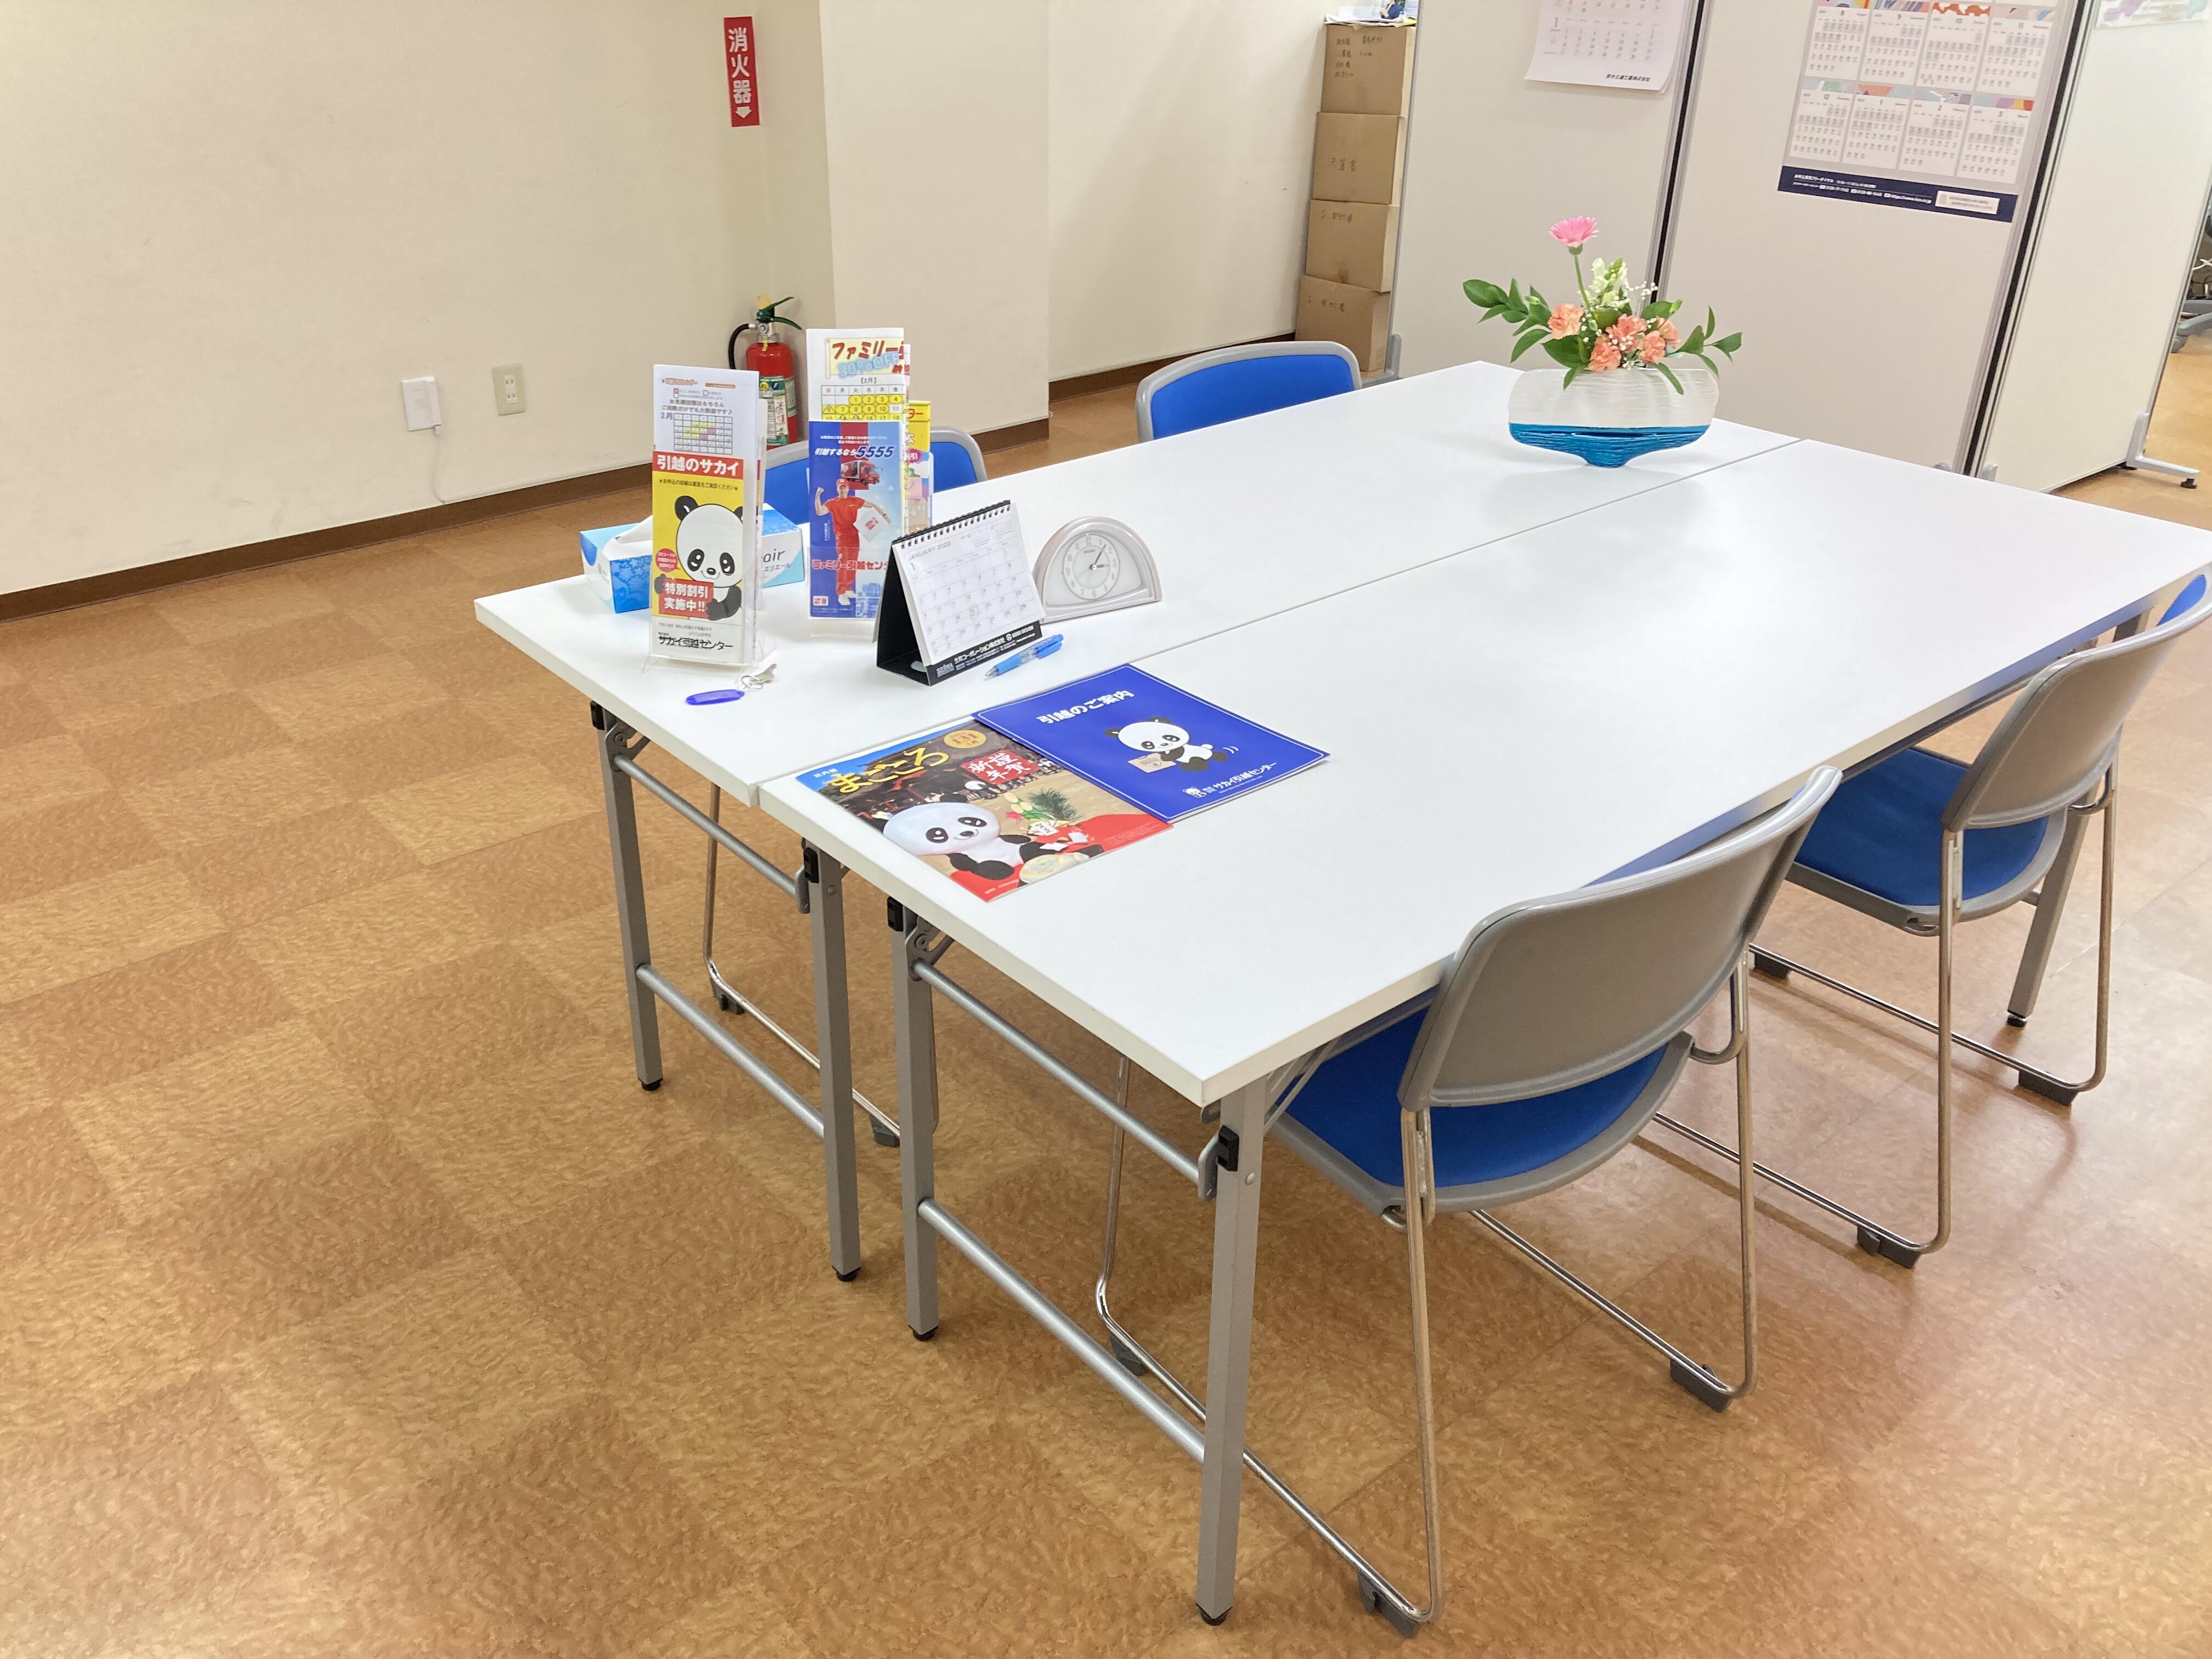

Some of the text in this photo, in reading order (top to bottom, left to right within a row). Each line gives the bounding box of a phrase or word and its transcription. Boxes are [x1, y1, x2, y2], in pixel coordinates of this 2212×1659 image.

[728, 27, 752, 104] 消火器
[839, 353, 900, 377] 30%OFF
[657, 455, 740, 477] 引越のサカイ
[763, 549, 786, 563] air
[908, 541, 951, 561] JANUARY 2022
[764, 563, 792, 572] エリエール
[664, 582, 708, 599] 特別割引
[664, 597, 705, 612] 実施中!!
[658, 635, 733, 650] サカイ引越センター
[1036, 690, 1135, 724] 引越のご案内
[822, 747, 950, 793] まごころ
[1212, 762, 1277, 789] サカイ引越センター
